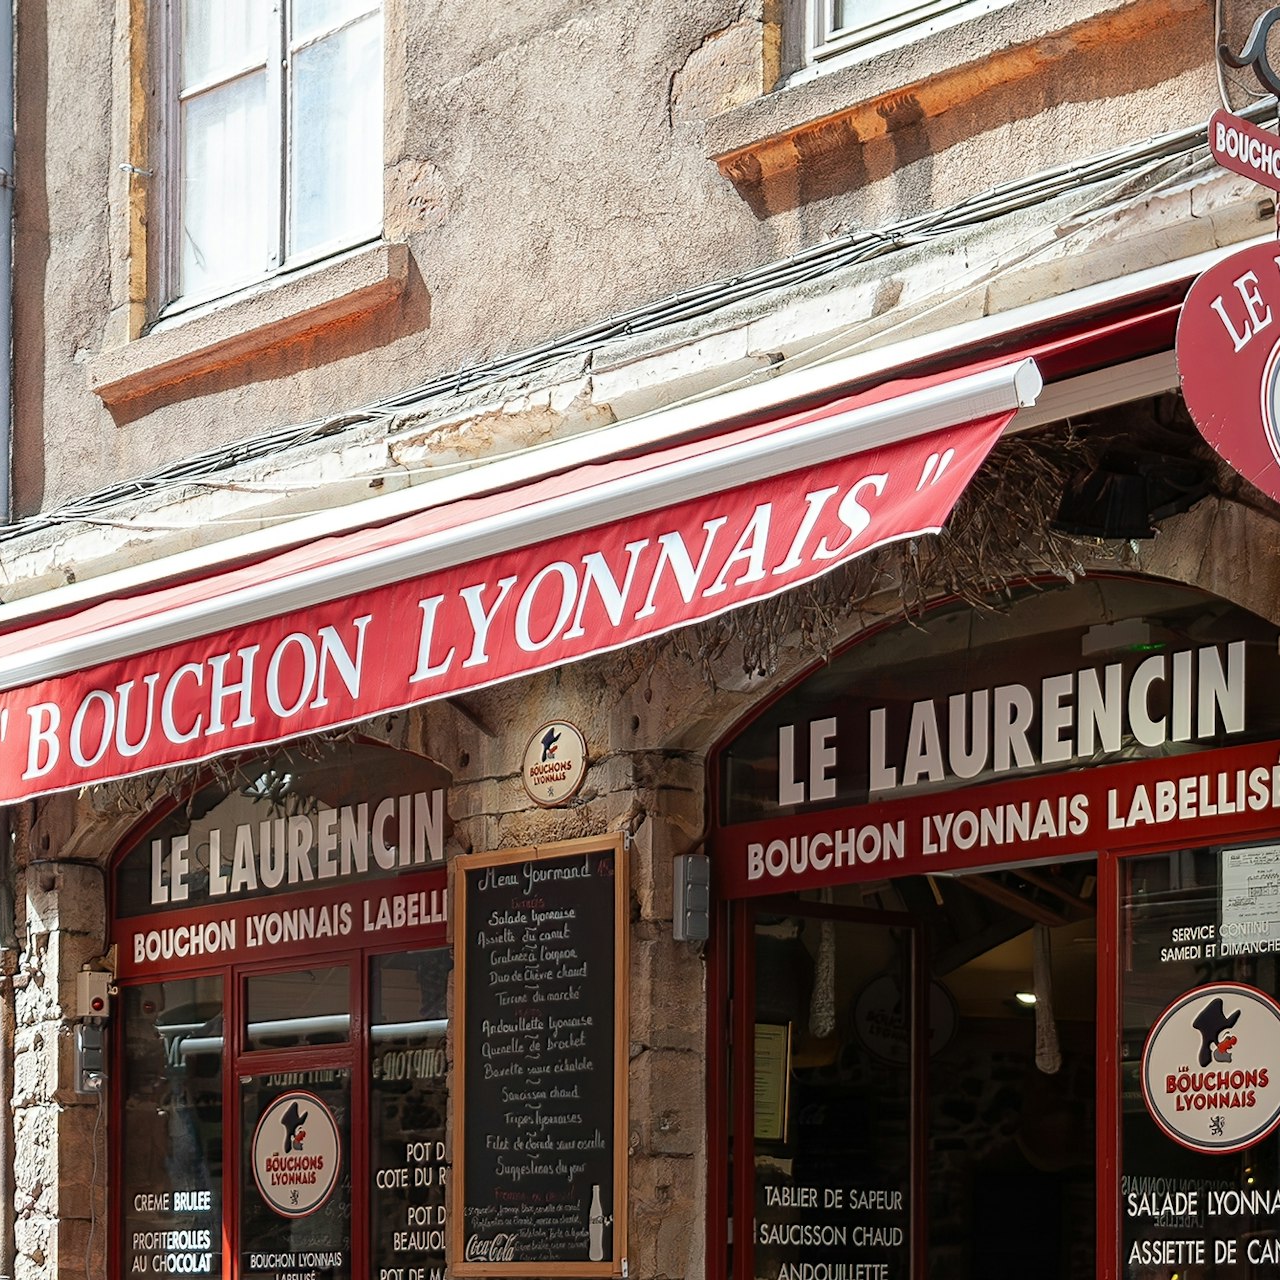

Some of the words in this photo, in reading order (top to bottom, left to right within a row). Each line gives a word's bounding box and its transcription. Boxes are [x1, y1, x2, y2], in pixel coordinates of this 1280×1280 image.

[1213, 270, 1274, 354] LE
[778, 717, 837, 806] LE
[869, 641, 1246, 792] LAURENCIN
[530, 760, 572, 777] BOUCHONS
[533, 772, 566, 785] LYONNAIS
[151, 833, 190, 905] LE
[209, 788, 443, 896] LAURENCIN
[747, 820, 905, 881] BOUCHON
[922, 793, 1090, 855] LYONNAIS
[478, 868, 519, 890] Menu
[488, 909, 527, 926] Salade
[134, 918, 236, 964] BOUCHON
[246, 901, 352, 948] LYONNAIS
[522, 930, 536, 942] du
[539, 923, 570, 941] canut
[1172, 925, 1214, 942] SERVICE
[1220, 921, 1269, 938] CONTINU
[1161, 946, 1201, 962] SAMEDI
[1205, 943, 1216, 957] ET
[1221, 939, 1280, 956] DIMANCHE
[489, 971, 509, 986] Duo
[511, 970, 522, 981] de
[557, 962, 587, 978] chaud
[533, 989, 545, 1002] du
[482, 1016, 544, 1037] Andouillette
[482, 1037, 524, 1059] Quenelle
[529, 1040, 540, 1051] de
[1166, 1068, 1269, 1093] BOUCHONS
[502, 1086, 547, 1102] Saucisson
[549, 1084, 581, 1098] chaud
[1176, 1090, 1256, 1111] LYONNAIS
[407, 1142, 431, 1162] POT
[486, 1134, 509, 1150] Filet
[265, 1155, 323, 1172] BOUCHONS
[556, 1159, 568, 1175] du
[271, 1171, 316, 1186] LYONNAIS
[376, 1168, 408, 1189] COTE
[414, 1168, 433, 1187] DU
[134, 1193, 169, 1211] CREME
[173, 1191, 211, 1212] BRULEE
[765, 1186, 818, 1208] TABLIER
[824, 1189, 842, 1209] DE
[849, 1189, 902, 1210] SAPEUR
[1127, 1191, 1198, 1217] SALADE
[408, 1206, 433, 1226] POT
[133, 1230, 211, 1250] PROFITEROLLES
[759, 1224, 846, 1246] SAUCISSON
[852, 1226, 903, 1246] CHAUD
[132, 1255, 147, 1272] AU
[152, 1253, 212, 1273] CHOCOLAT
[250, 1253, 295, 1268] BOUCHON
[298, 1251, 342, 1267] LYONNAIS
[1128, 1240, 1205, 1265] ASSIETTE
[1214, 1240, 1237, 1264] DE
